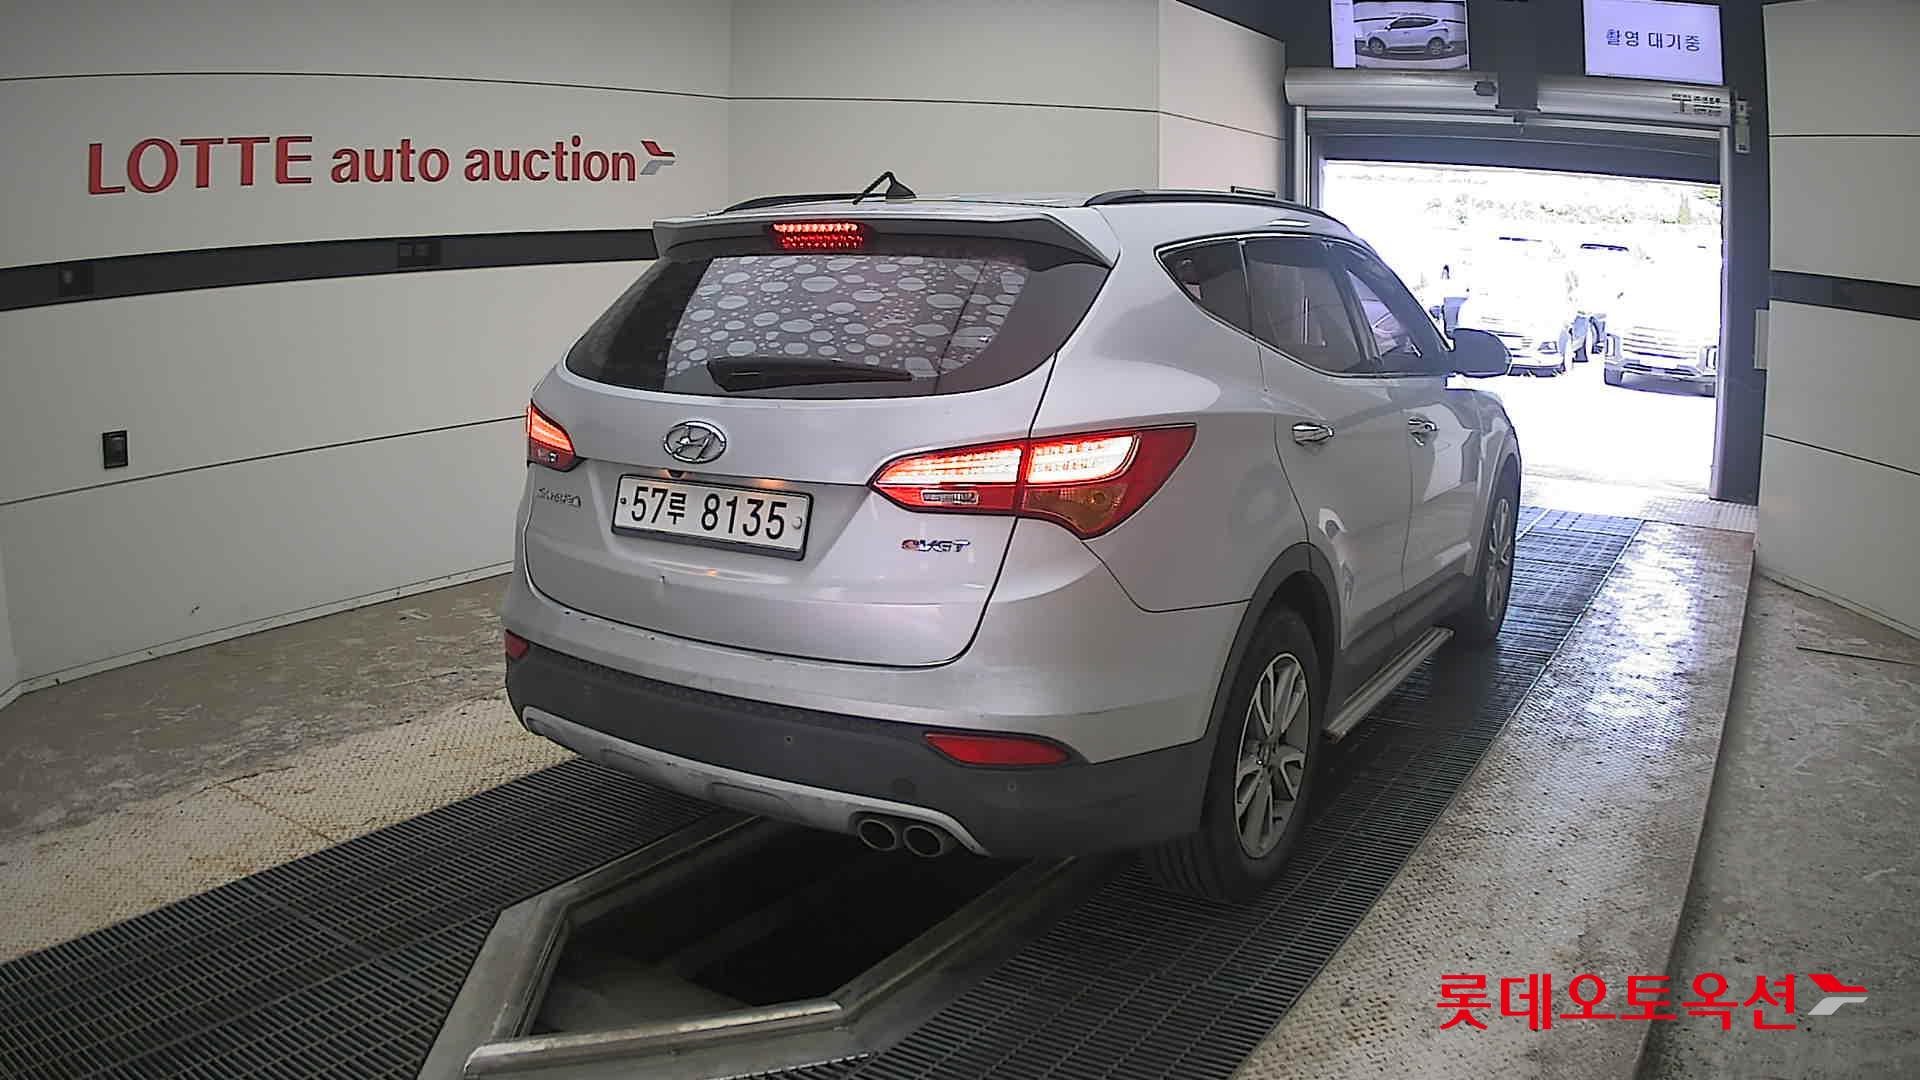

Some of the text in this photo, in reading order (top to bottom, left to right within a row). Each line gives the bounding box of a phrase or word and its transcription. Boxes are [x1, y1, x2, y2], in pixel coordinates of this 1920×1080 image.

[1606, 28, 1701, 52] 촬영 대기중
[88, 135, 637, 195] LOTTE auto auction
[631, 486, 688, 525] 57루
[701, 493, 788, 540] 8135
